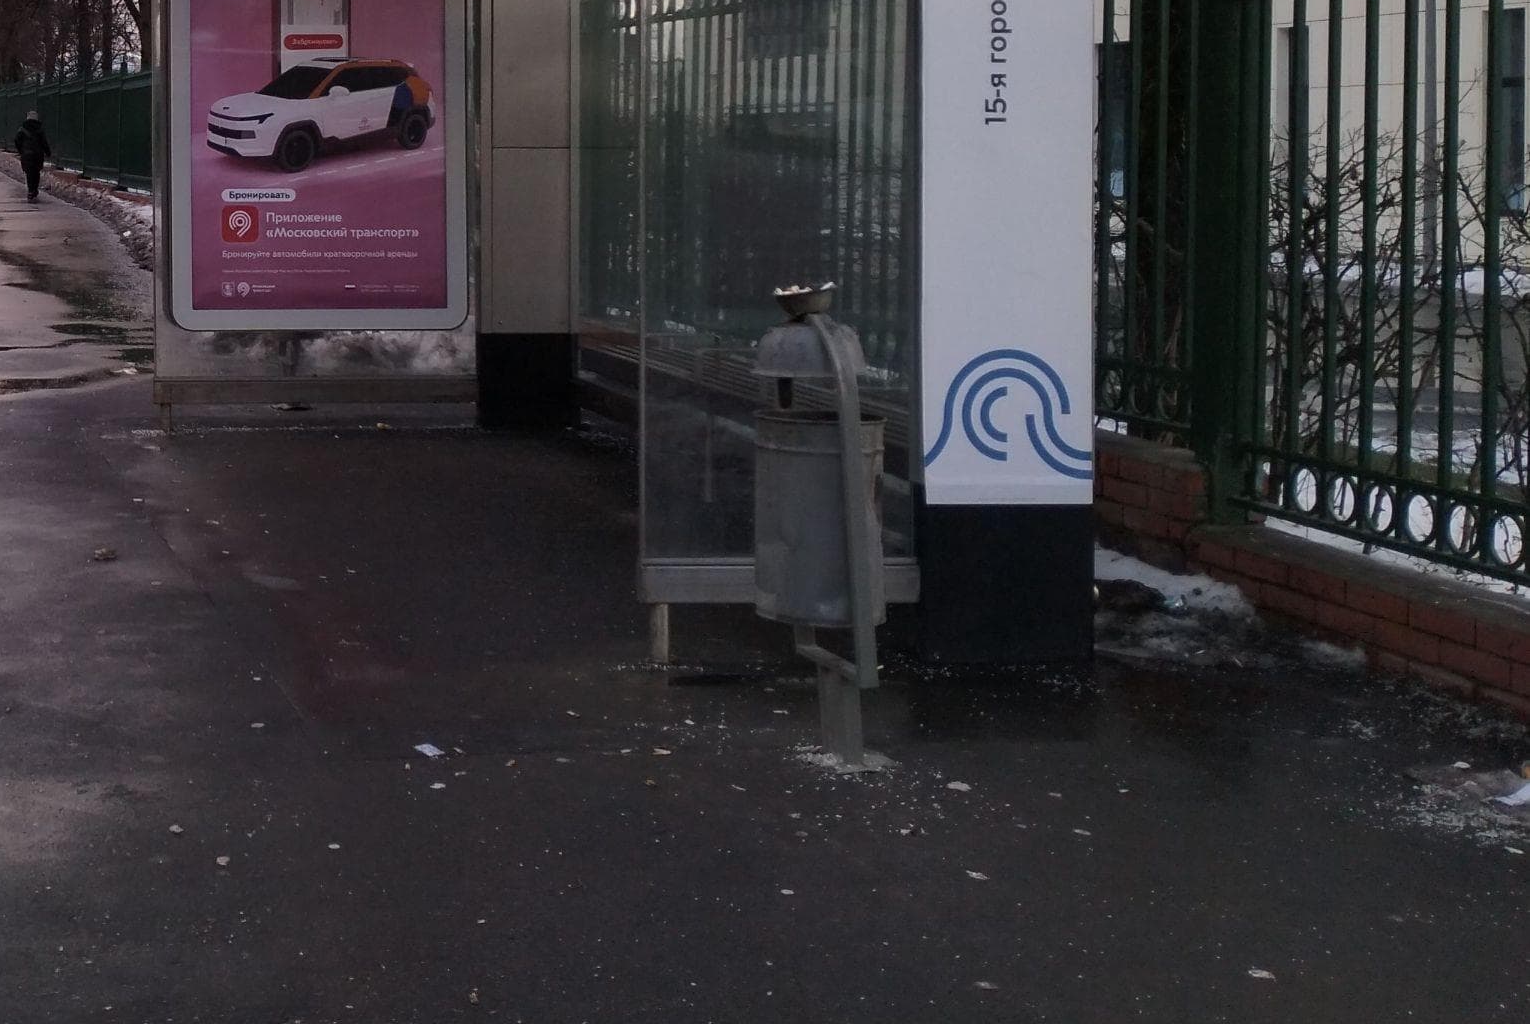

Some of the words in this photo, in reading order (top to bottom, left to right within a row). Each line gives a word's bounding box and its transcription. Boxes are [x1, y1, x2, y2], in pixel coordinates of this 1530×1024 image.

[985, 73, 1007, 126] 15-я
[229, 191, 291, 200] Бронировать
[266, 212, 342, 223] Приложение
[266, 227, 348, 238] «Московский
[351, 228, 419, 239] транспорт»
